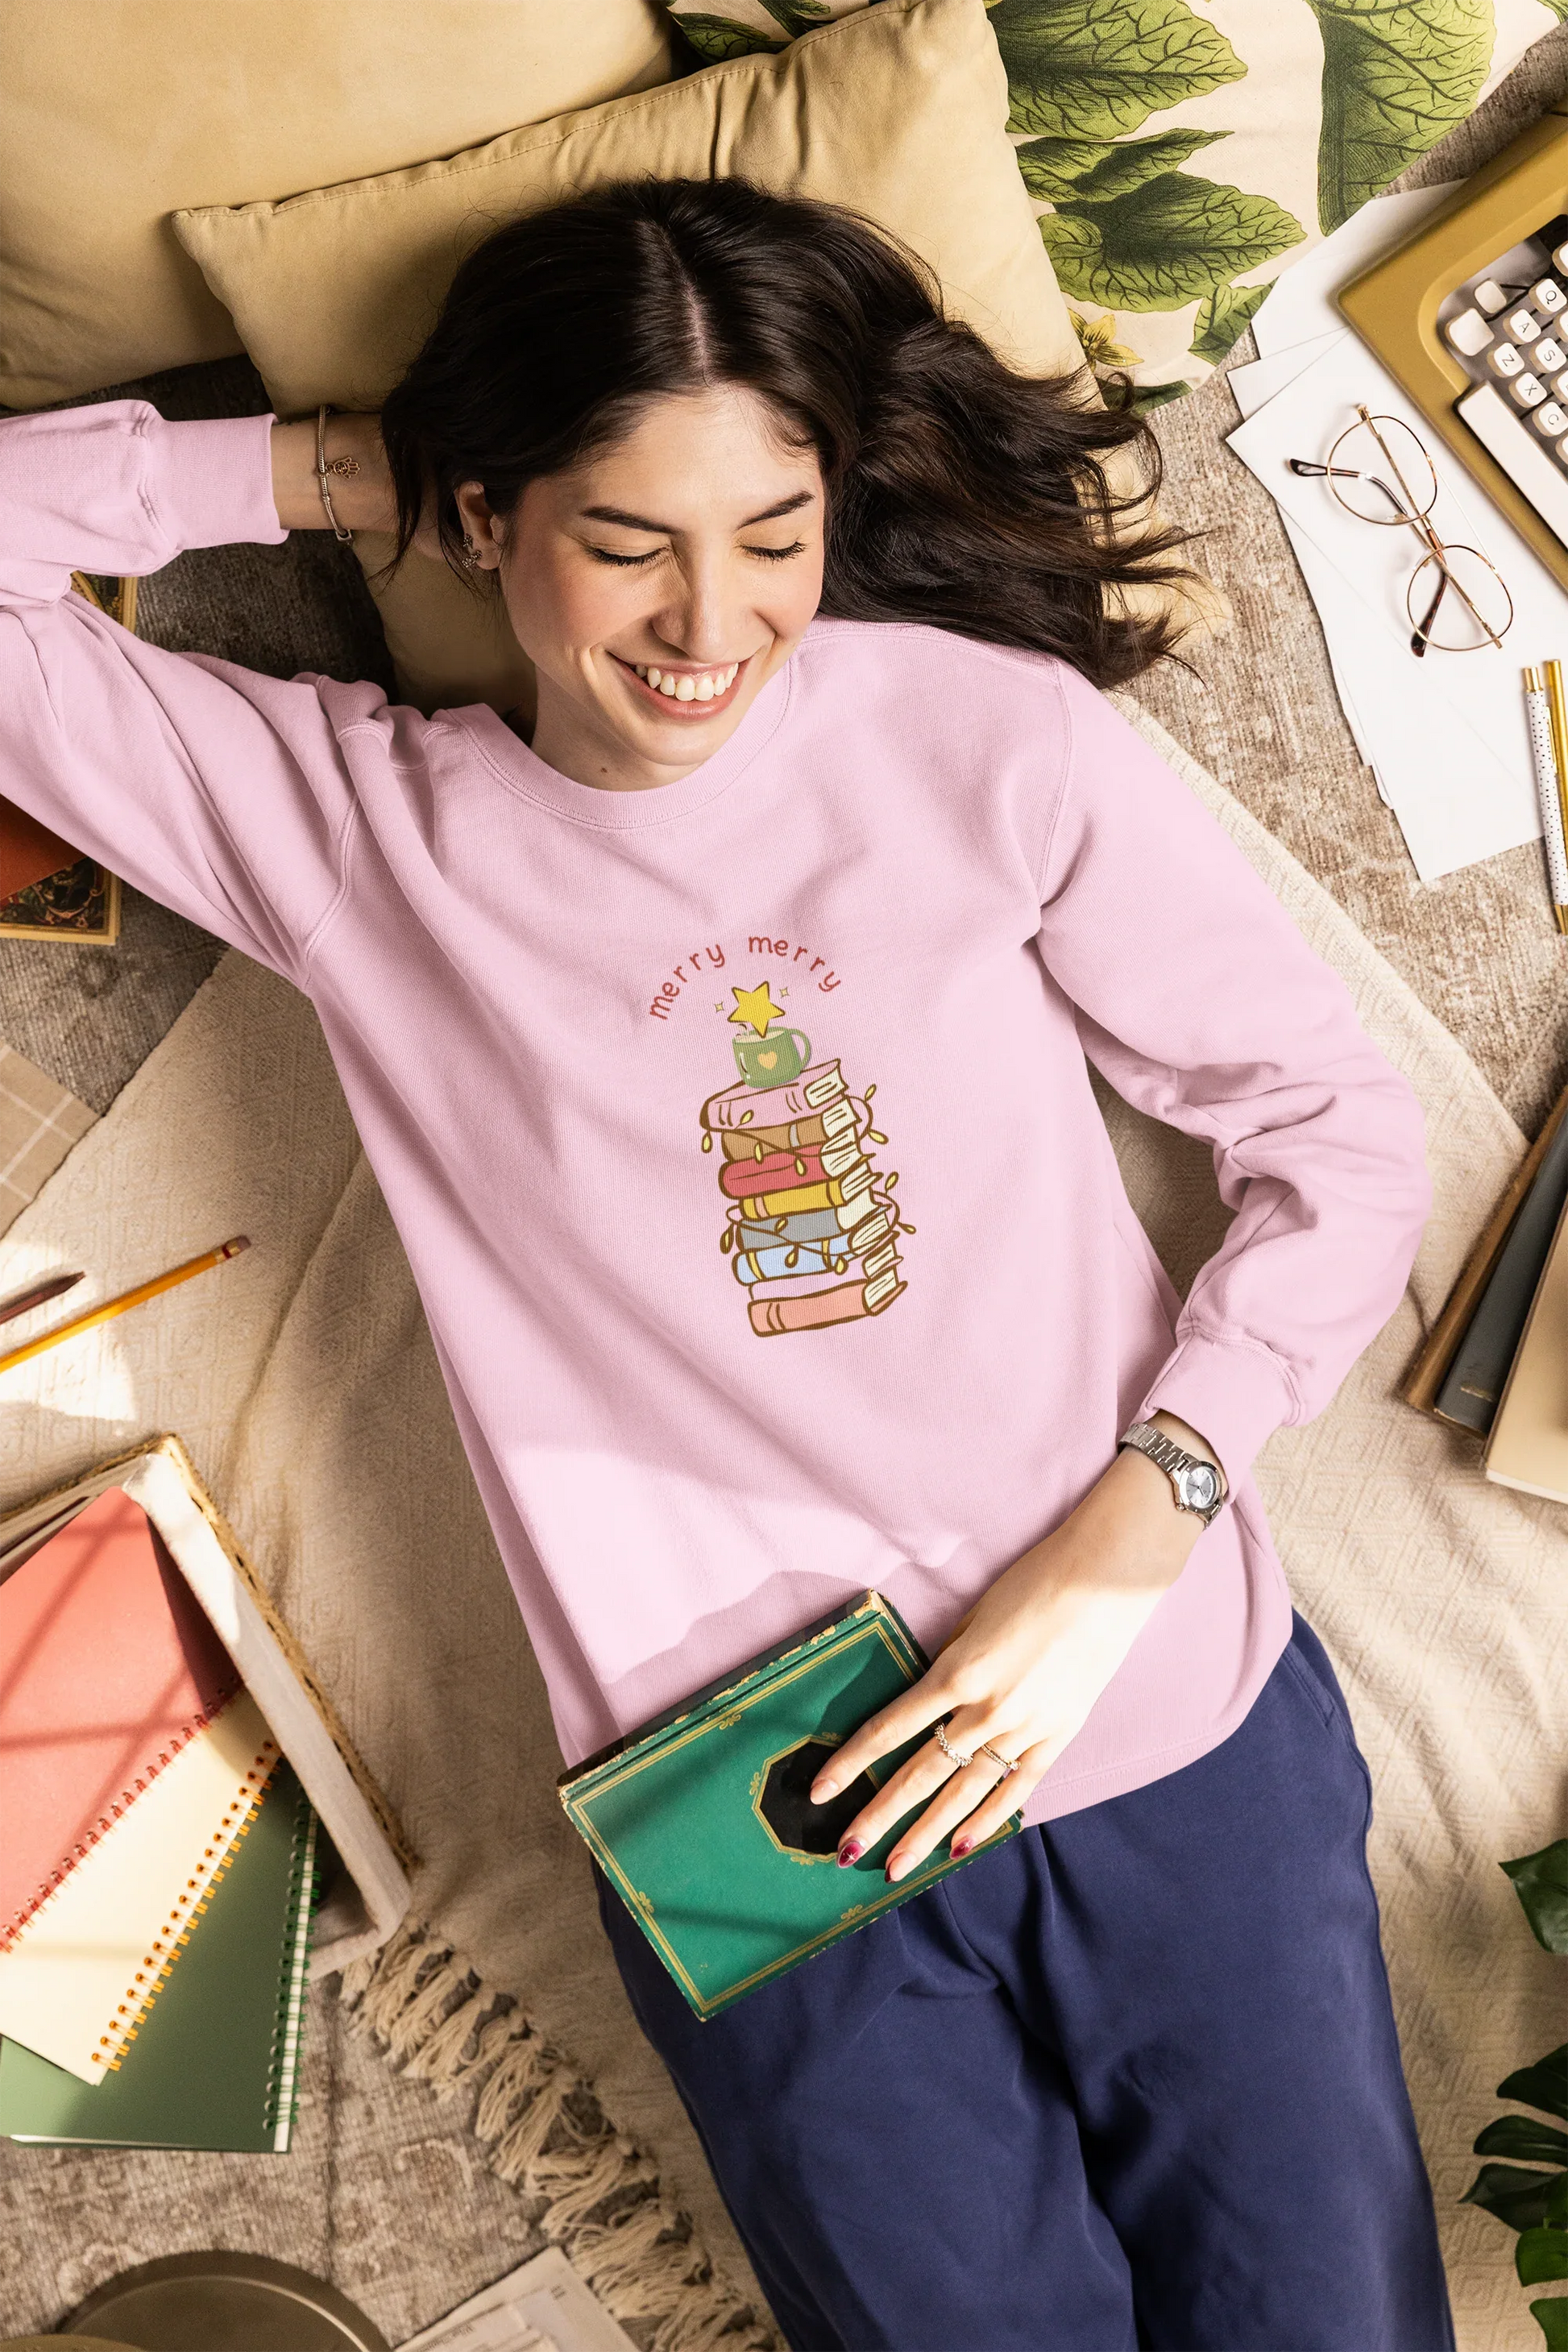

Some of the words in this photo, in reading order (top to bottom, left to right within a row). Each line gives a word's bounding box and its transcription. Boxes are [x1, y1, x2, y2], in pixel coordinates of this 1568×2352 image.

[1545, 290, 1557, 305] Q
[1519, 322, 1530, 334] A
[1501, 353, 1515, 367] Z
[1544, 349, 1556, 362] S
[1524, 383, 1537, 396] X
[1547, 413, 1559, 425] C
[649, 944, 726, 1020] merry
[748, 936, 841, 993] merry
